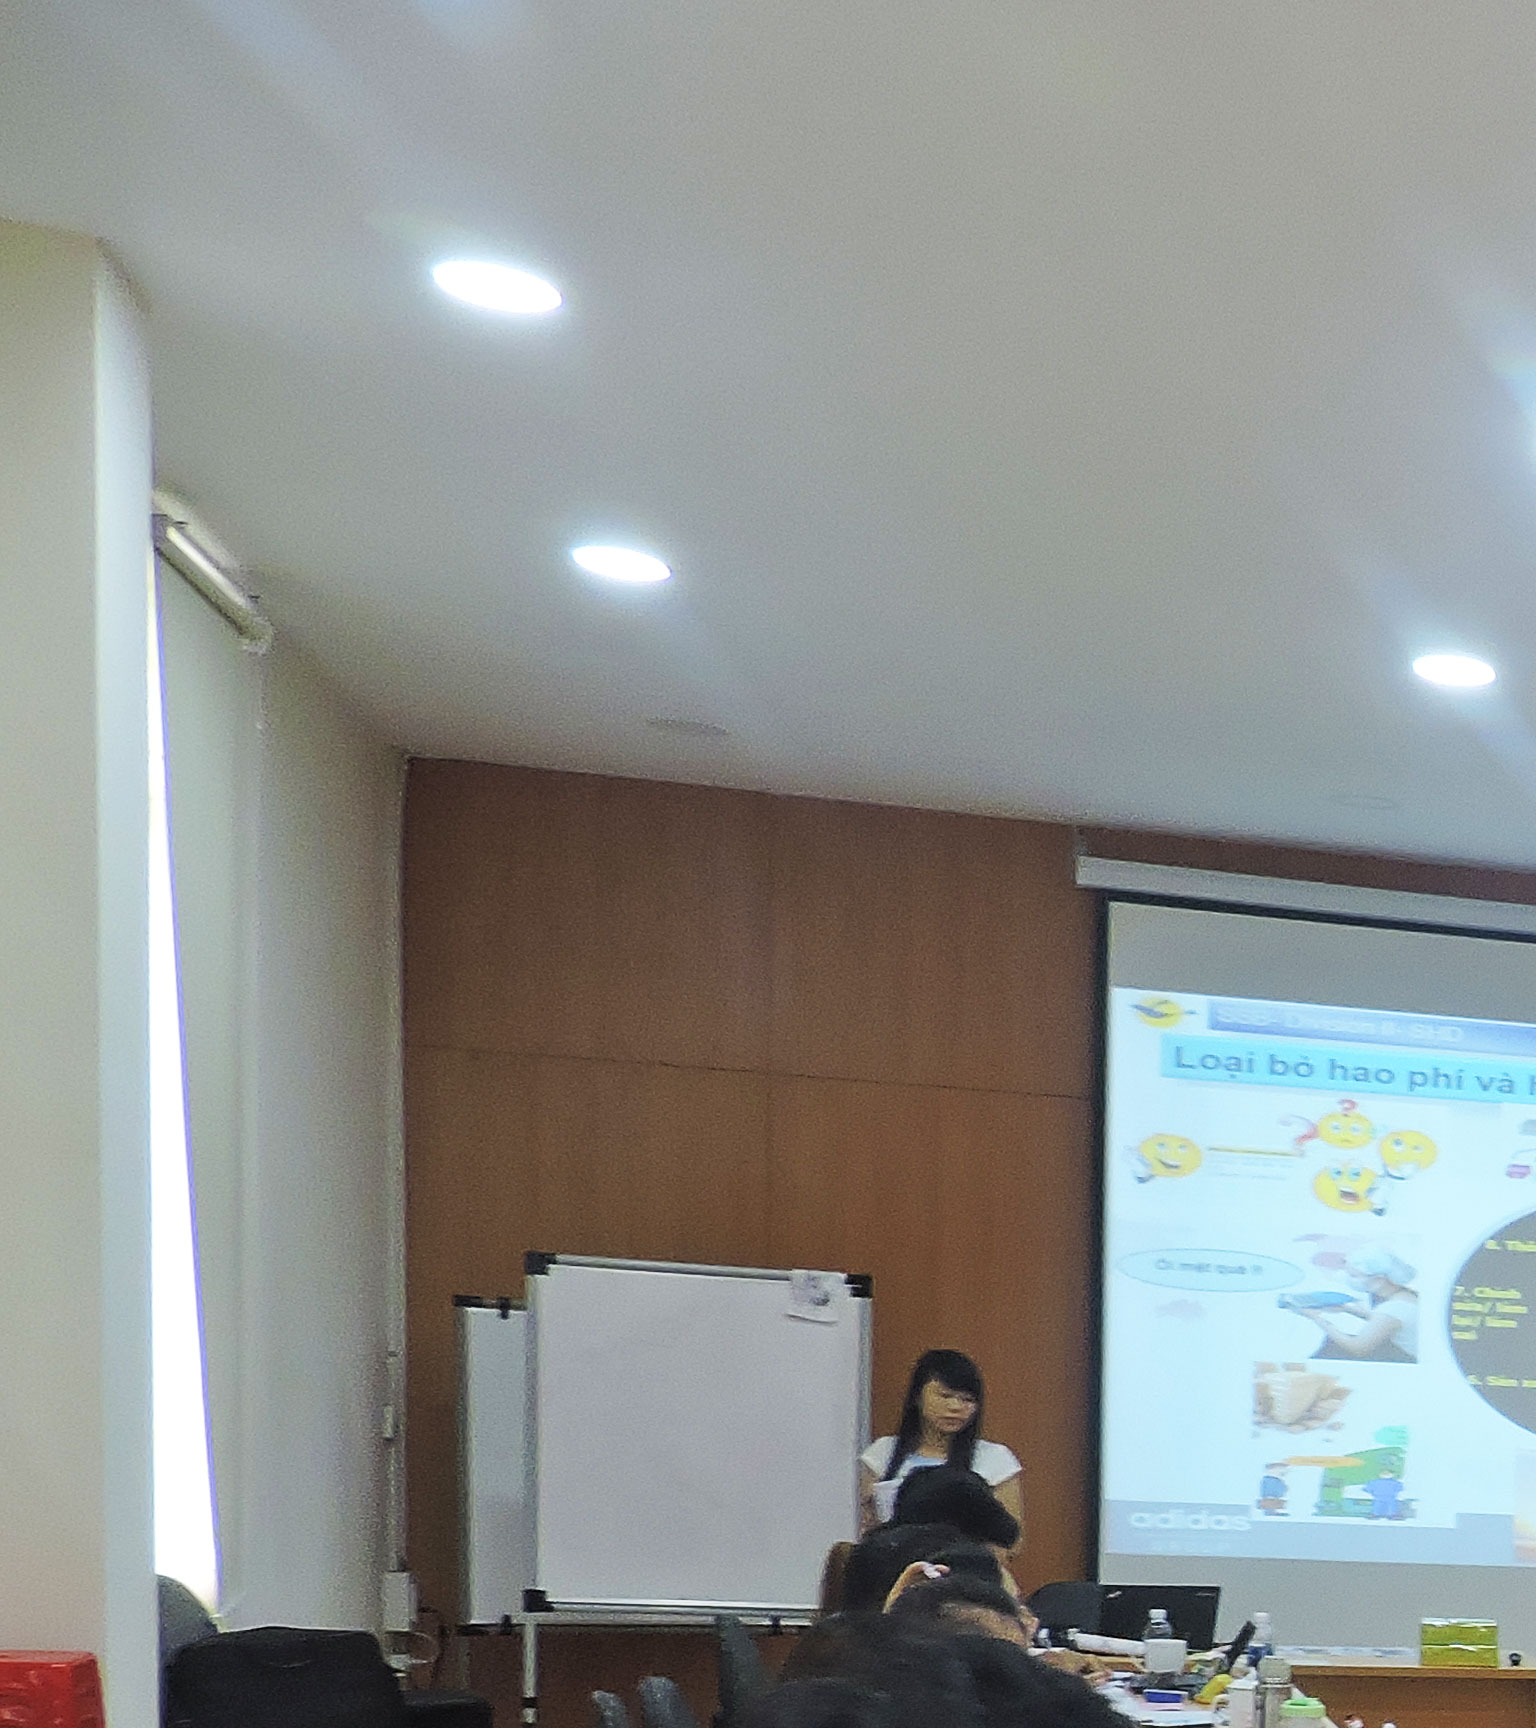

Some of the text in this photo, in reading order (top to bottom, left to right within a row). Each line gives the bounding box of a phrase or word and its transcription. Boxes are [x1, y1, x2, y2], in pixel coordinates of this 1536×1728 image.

[1174, 1045, 1255, 1080] Loại
[1329, 1056, 1396, 1085] hao
[1408, 1064, 1464, 1092] phí
[1474, 1071, 1515, 1095] và
